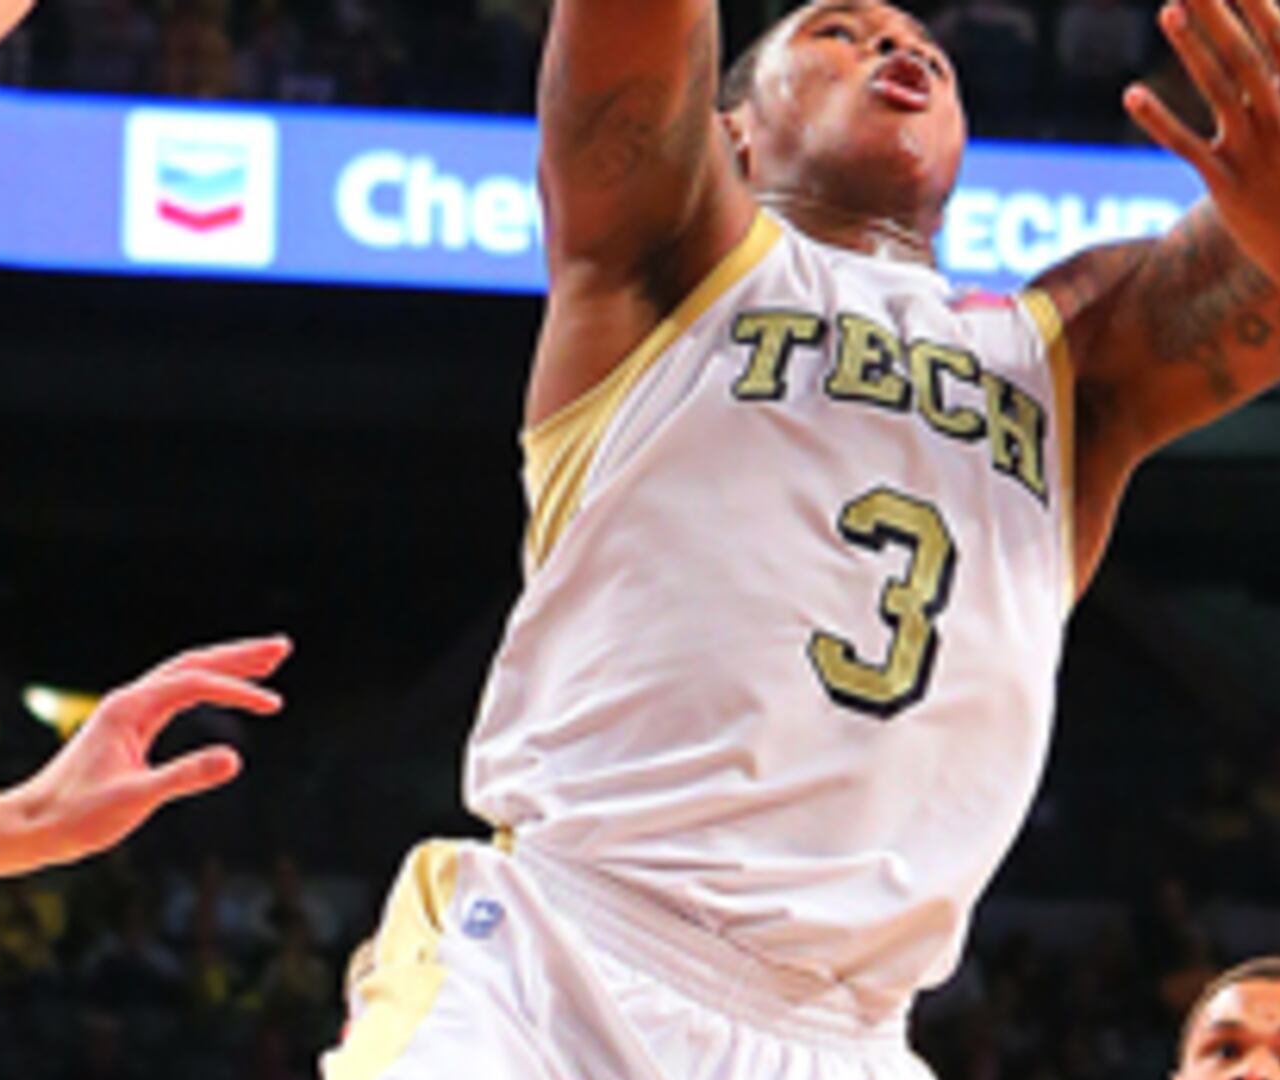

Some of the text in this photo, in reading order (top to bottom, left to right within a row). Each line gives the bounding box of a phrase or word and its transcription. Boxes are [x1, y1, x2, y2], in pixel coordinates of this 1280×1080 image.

[332, 148, 549, 257] Che
[730, 310, 1051, 510] TECH
[807, 484, 958, 722] 3
